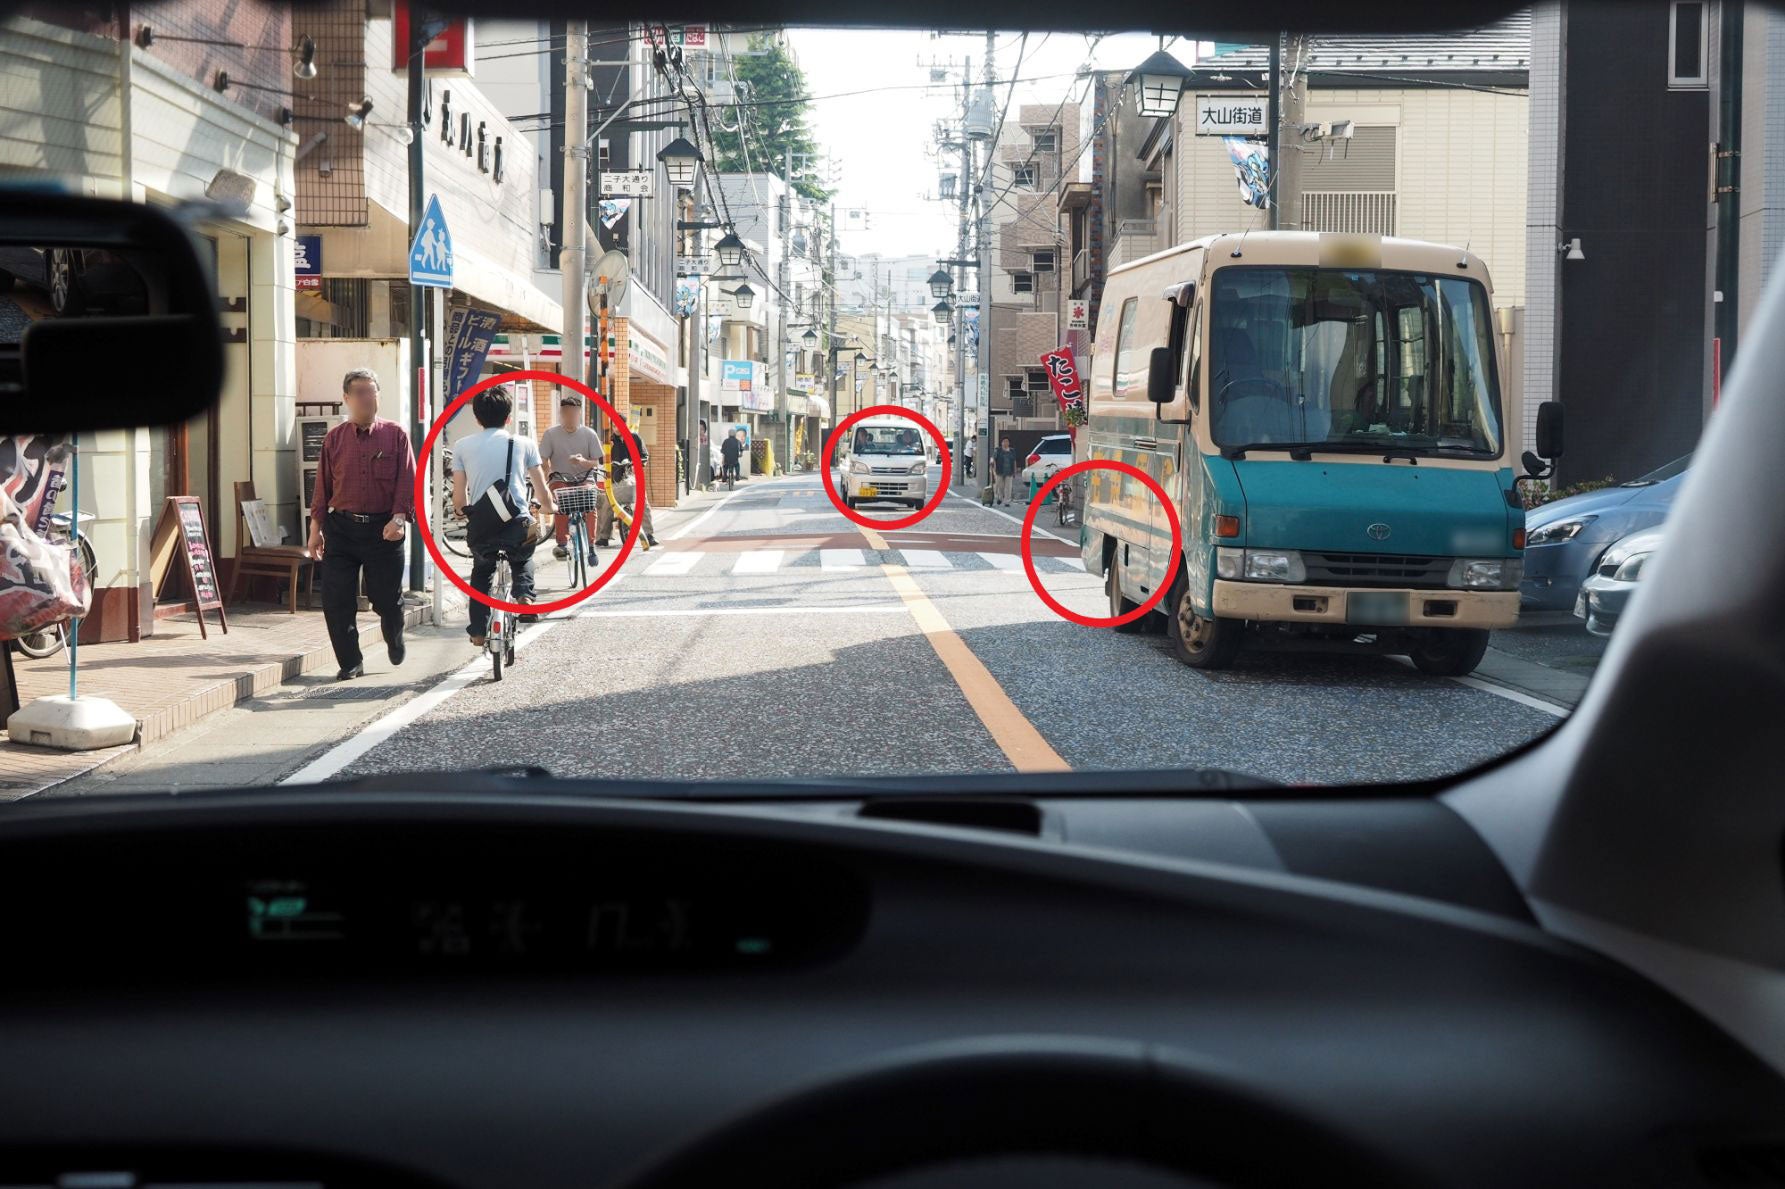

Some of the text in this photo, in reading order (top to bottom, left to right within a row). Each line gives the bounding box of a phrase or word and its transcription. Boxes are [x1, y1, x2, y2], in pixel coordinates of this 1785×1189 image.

[1202, 107, 1262, 124] 大山街道
[604, 175, 648, 183] 二子大通り
